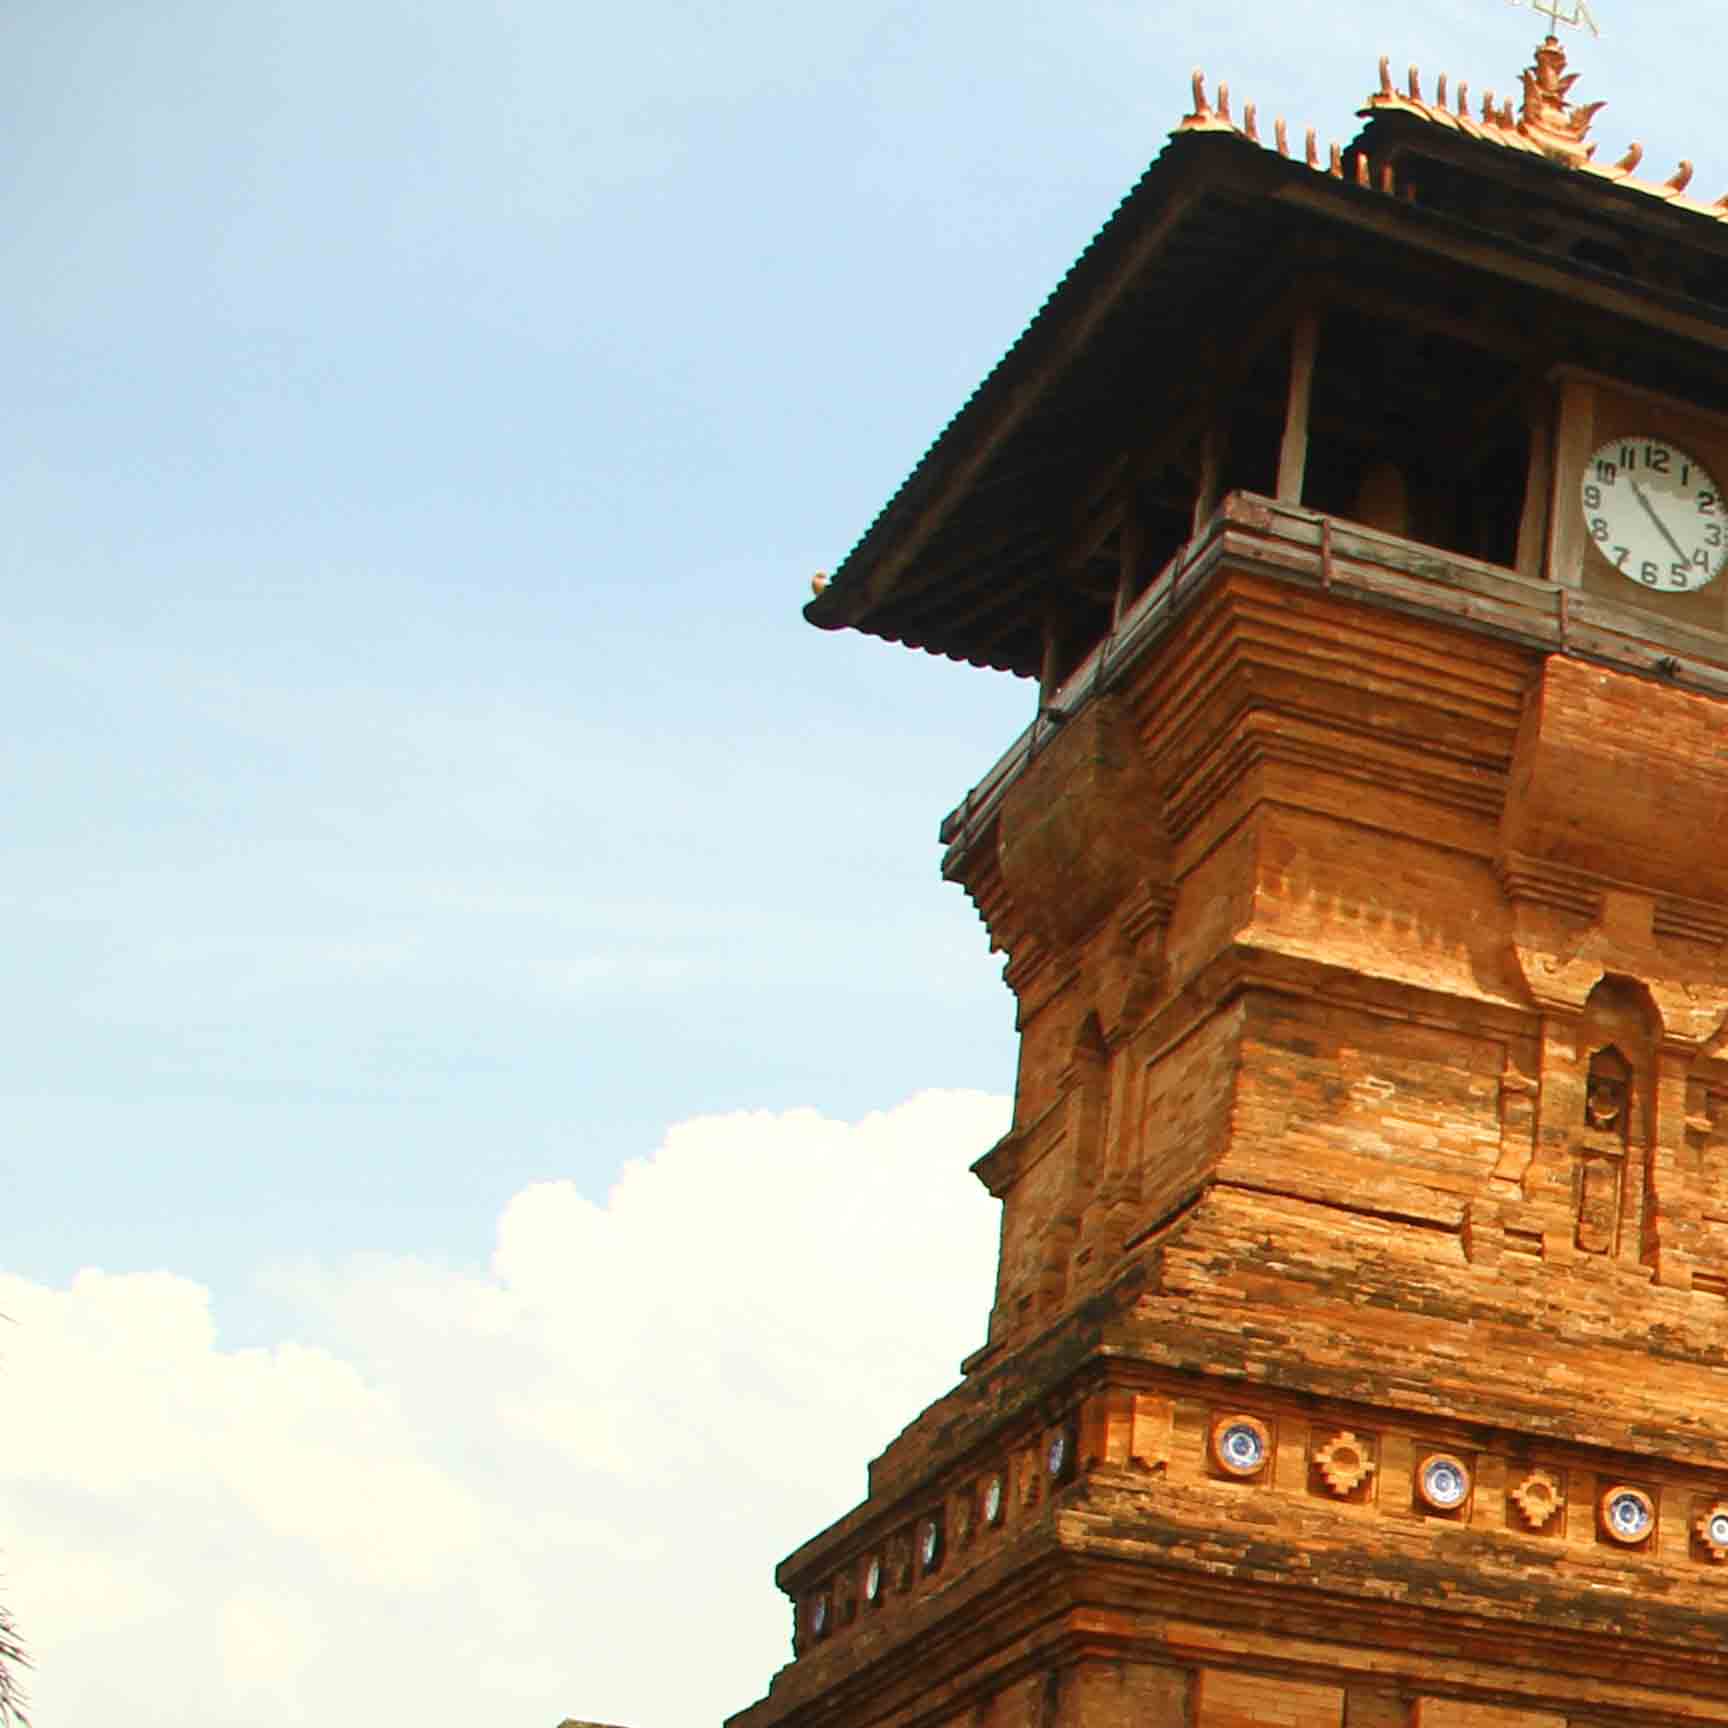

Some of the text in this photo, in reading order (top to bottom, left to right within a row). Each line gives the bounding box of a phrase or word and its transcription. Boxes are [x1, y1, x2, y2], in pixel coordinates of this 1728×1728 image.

[1620, 446, 1636, 471] 11
[1645, 446, 1671, 474] 12
[1597, 460, 1617, 486] 10
[1681, 464, 1689, 487] 1
[1697, 491, 1714, 515] 2
[1591, 518, 1609, 542] 8
[1704, 524, 1721, 547] 3
[1613, 546, 1631, 567] 7
[1693, 549, 1709, 573] 4
[1641, 561, 1659, 585] 6
[1671, 564, 1688, 587] 5
